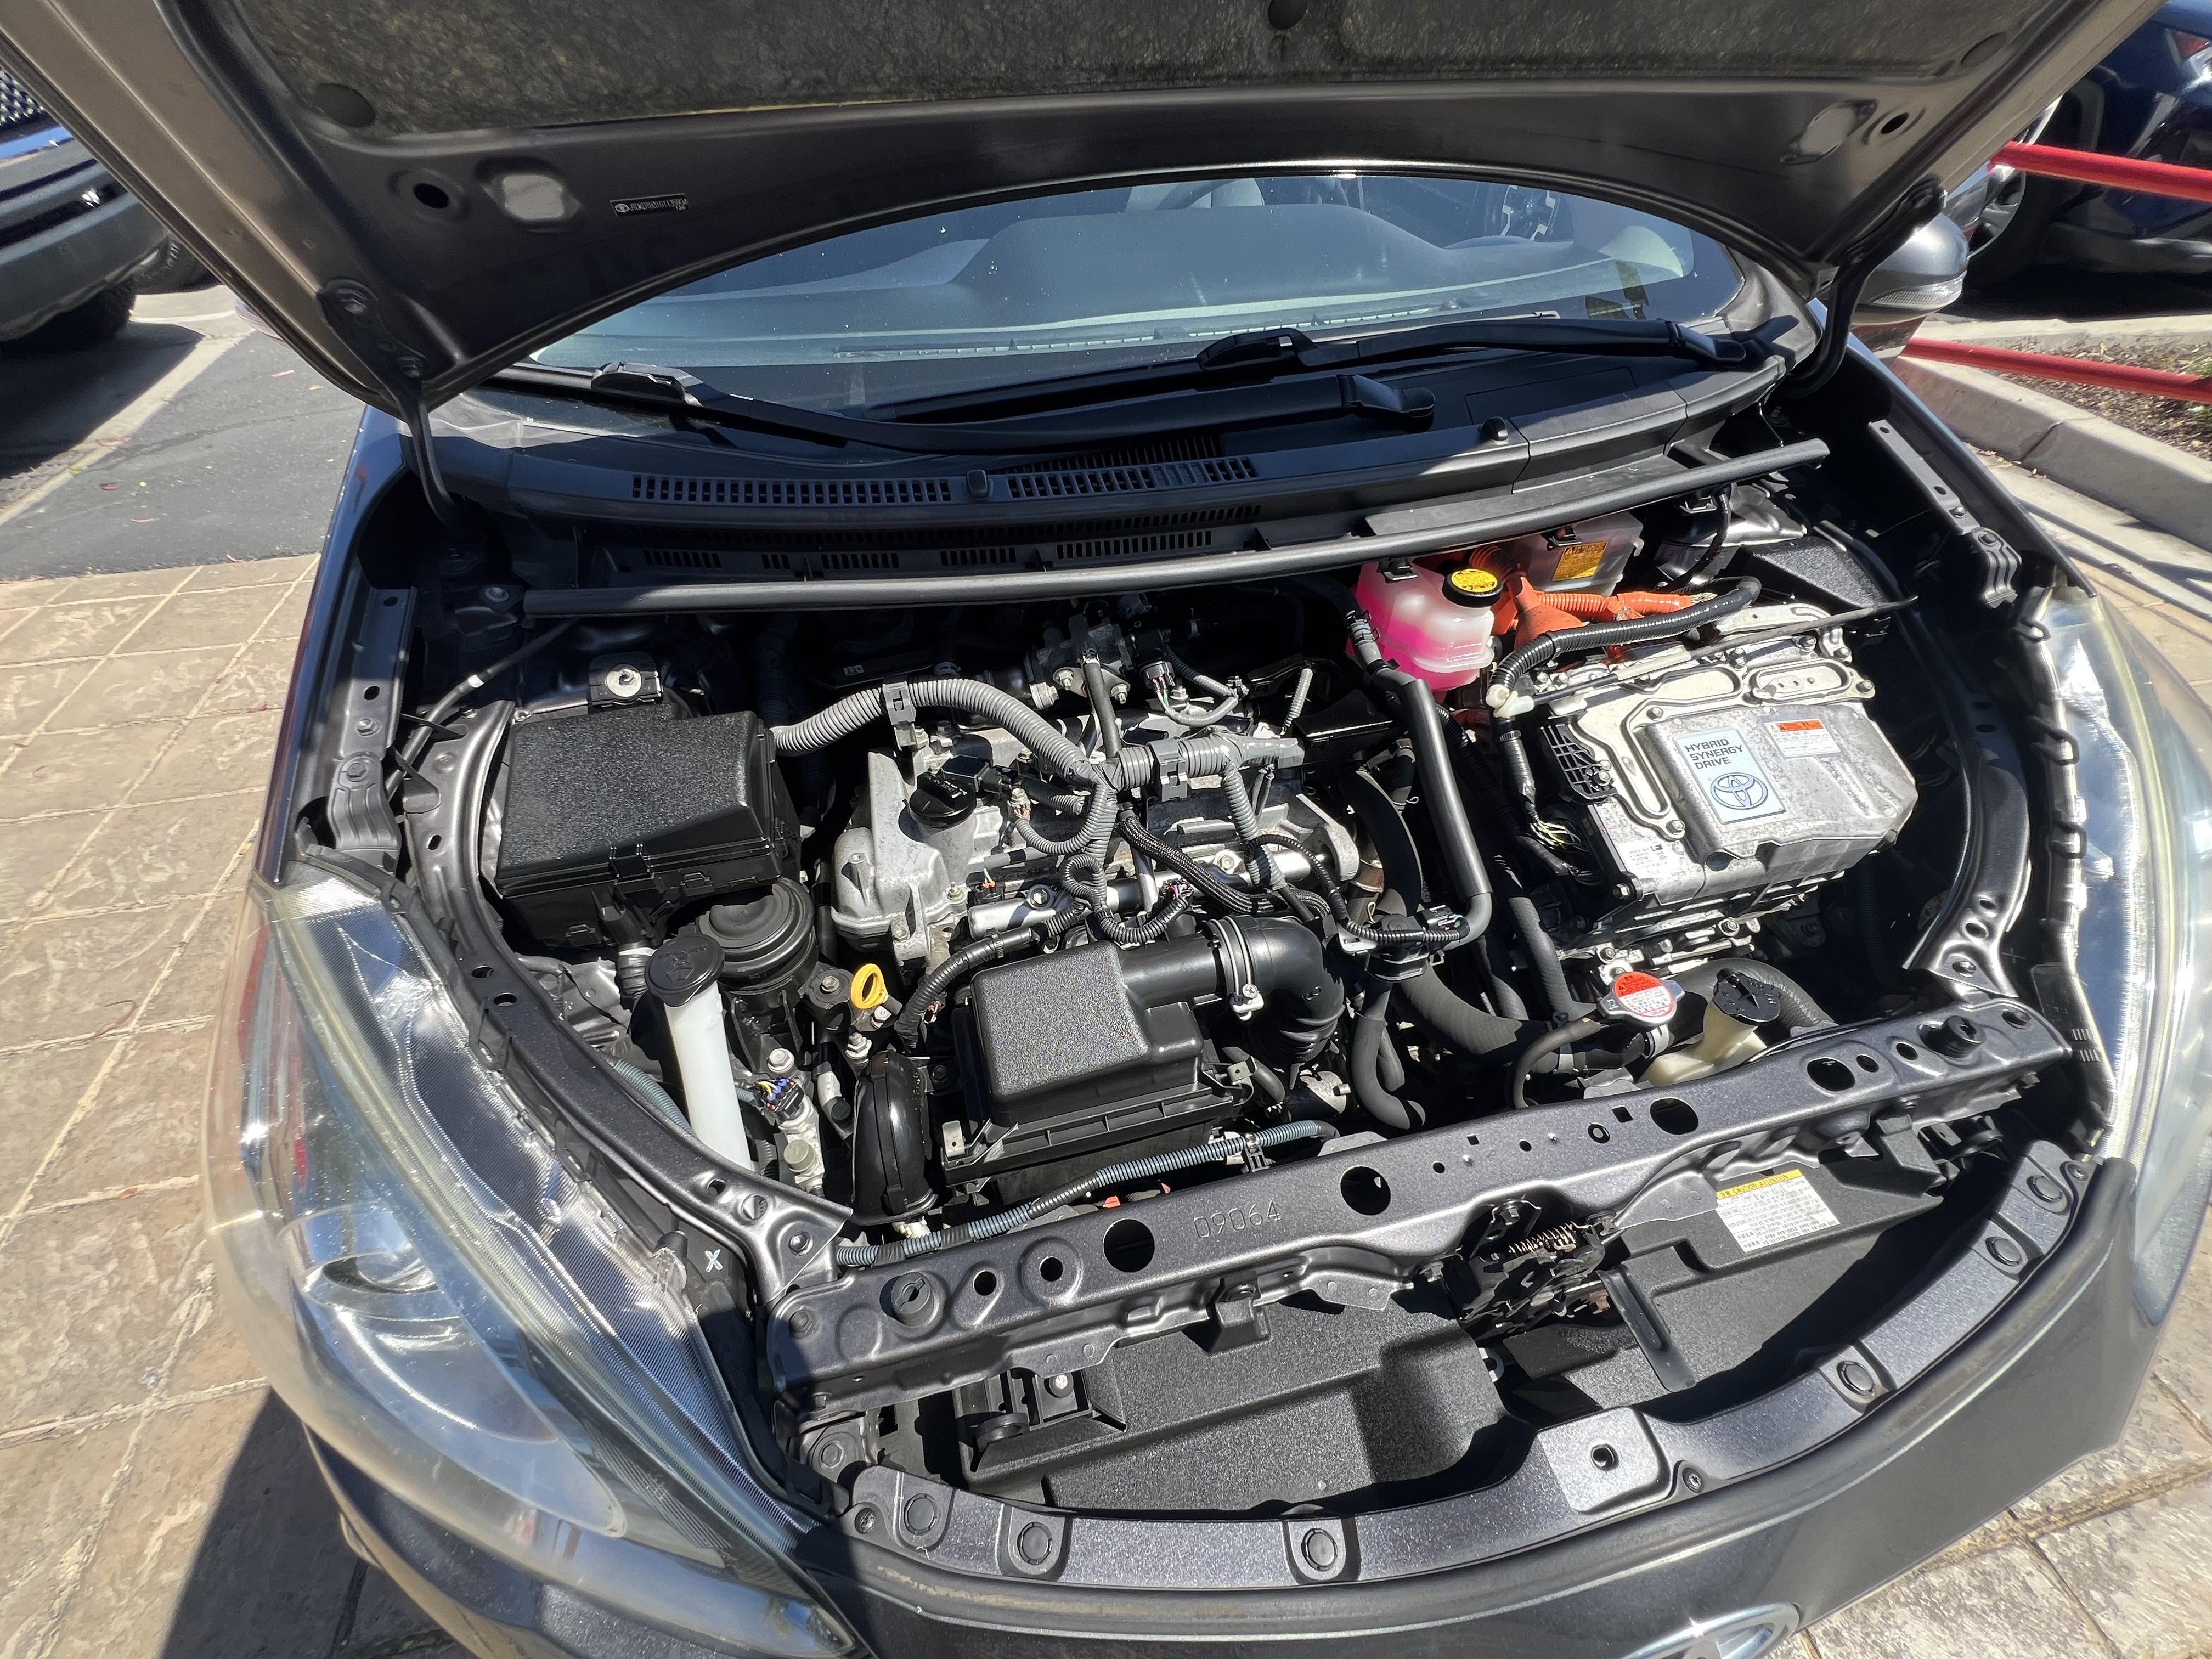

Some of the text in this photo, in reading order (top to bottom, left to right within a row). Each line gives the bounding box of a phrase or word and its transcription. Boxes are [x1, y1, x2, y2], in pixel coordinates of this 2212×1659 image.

[1684, 738, 1729, 752] HYBRID
[1689, 745, 1743, 761] SYNERGY
[1694, 757, 1731, 769] DRIVE
[1733, 1183, 1758, 1194] CAUTION
[1759, 1174, 1789, 1187] ATTENTION
[1193, 1199, 1282, 1239] 09064
